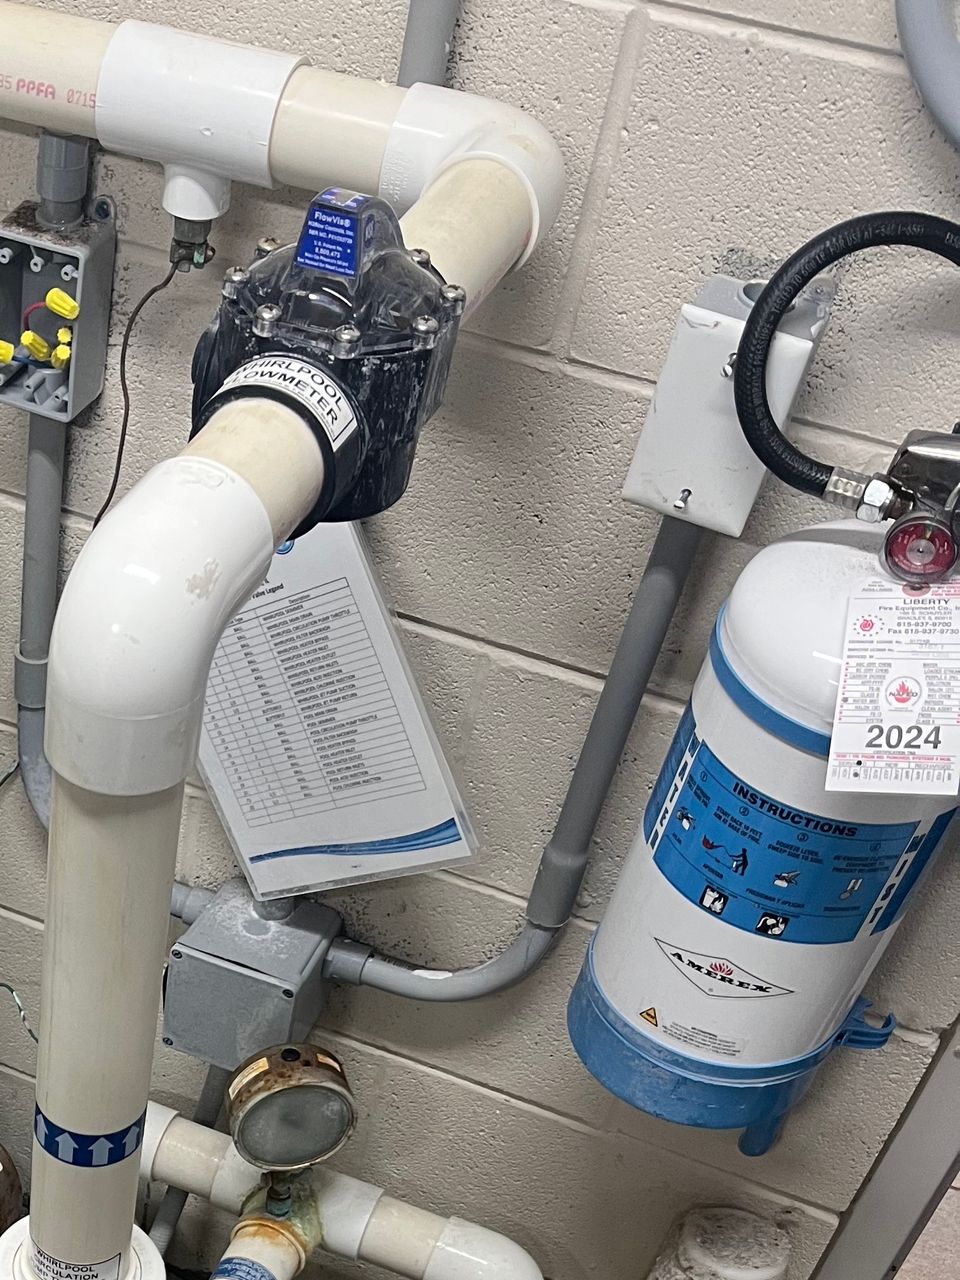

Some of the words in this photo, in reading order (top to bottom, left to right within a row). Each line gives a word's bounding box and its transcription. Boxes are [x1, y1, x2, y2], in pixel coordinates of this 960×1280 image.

[16, 79, 56, 100] PPFA
[236, 359, 342, 413] WHIRLPOOL
[865, 724, 942, 749] 2024
[733, 782, 858, 837] INSTRUCTIONS
[670, 952, 773, 993] AMEREX
[34, 1254, 99, 1280] RCULATION
[36, 1249, 95, 1273] WHIRLPOOL
